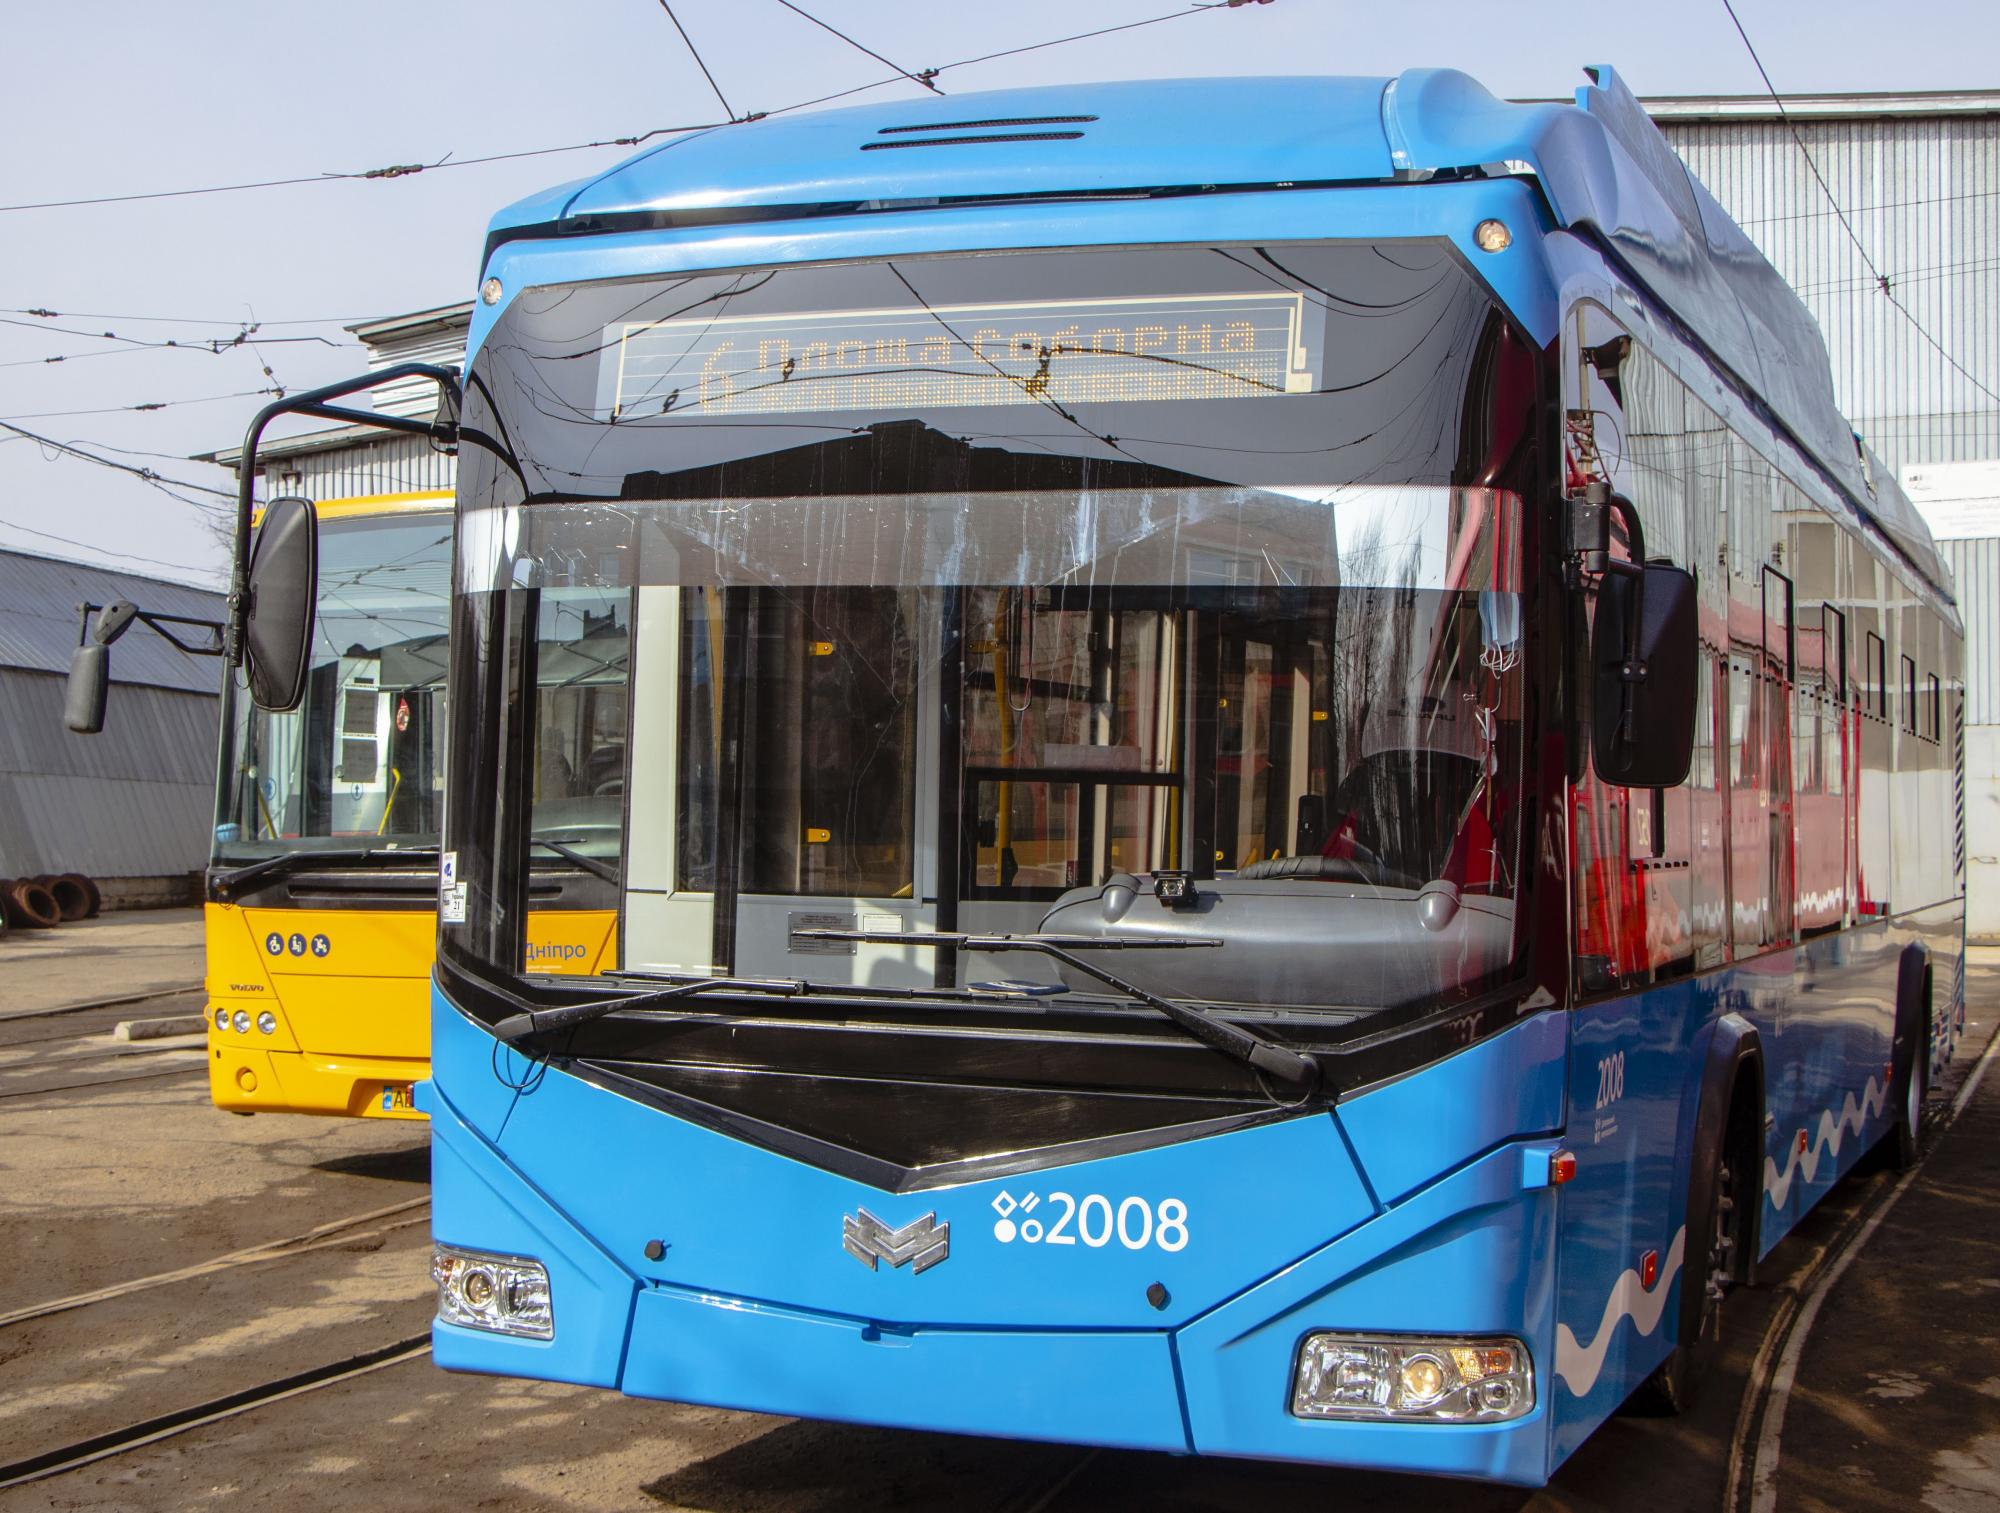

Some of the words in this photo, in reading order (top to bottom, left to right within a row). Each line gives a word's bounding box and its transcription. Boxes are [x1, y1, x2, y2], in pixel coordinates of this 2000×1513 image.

[700, 341, 734, 413] 6
[759, 336, 950, 371] Площа
[973, 322, 1255, 361] Соборна
[525, 941, 586, 960] Дніпро
[1596, 1050, 1624, 1110] 2008
[1045, 1191, 1189, 1252] 2008
